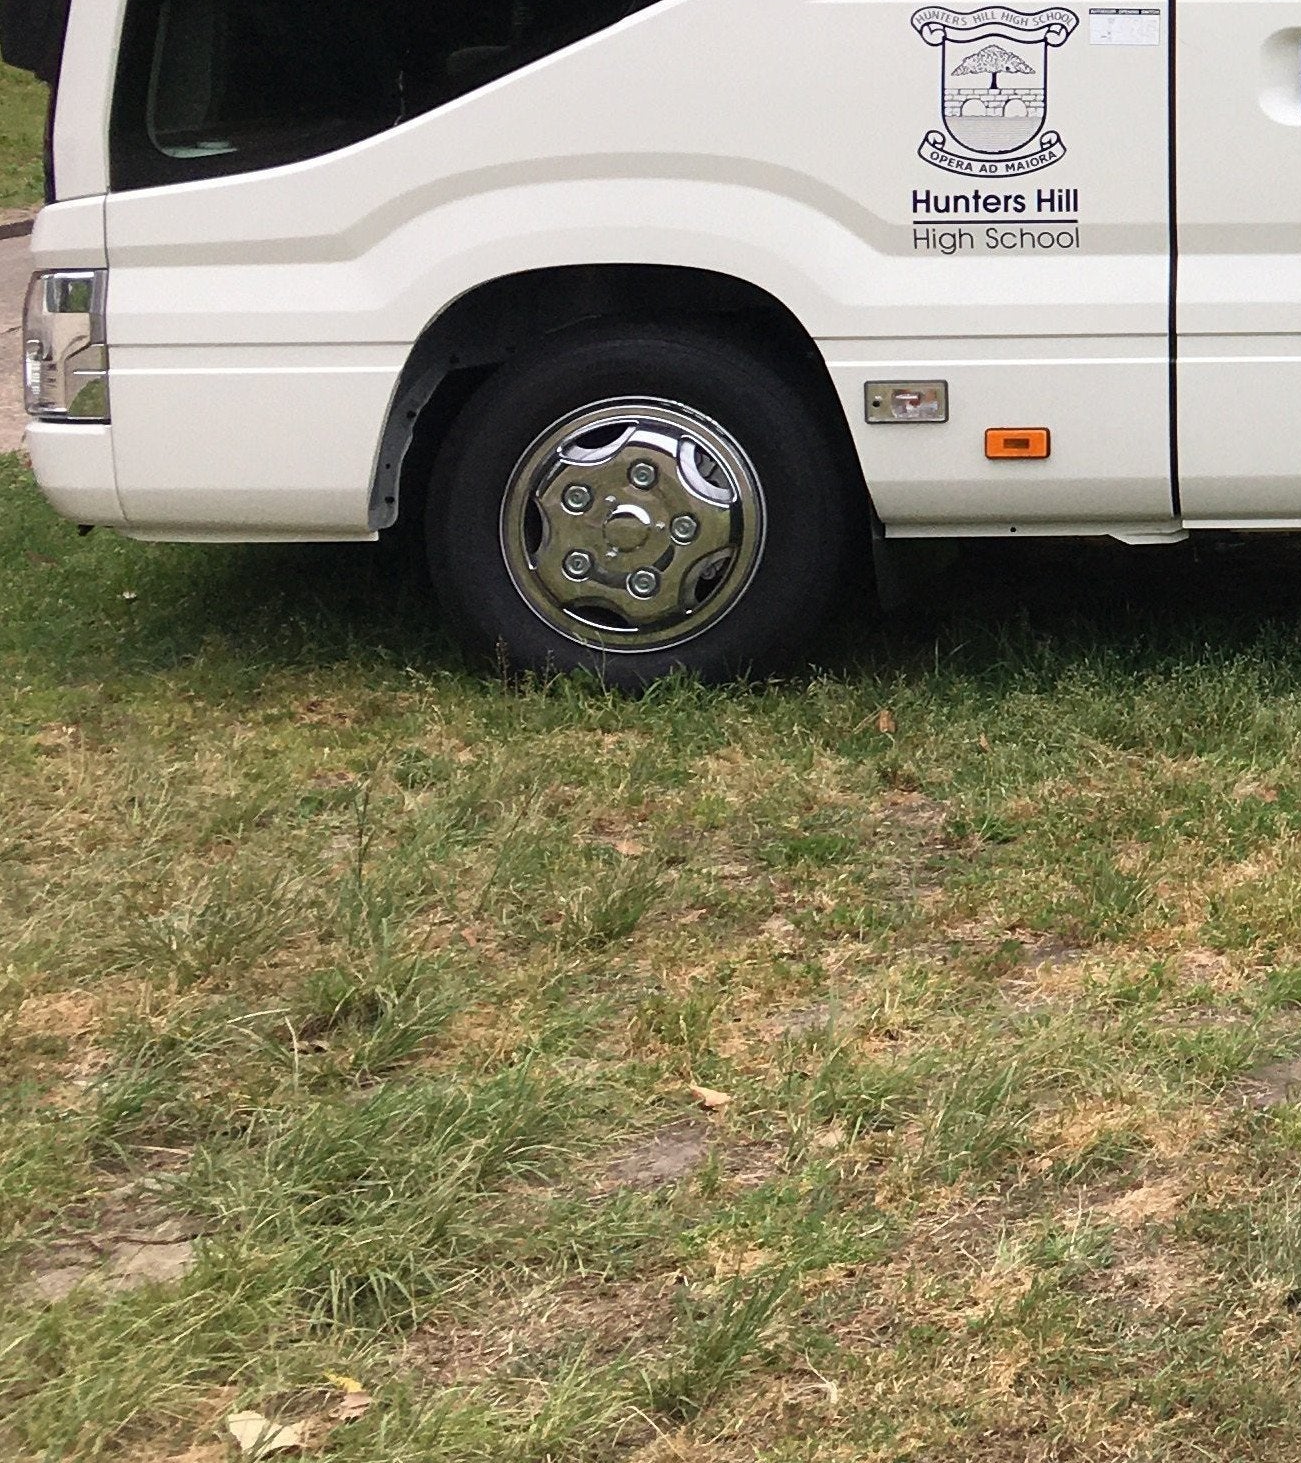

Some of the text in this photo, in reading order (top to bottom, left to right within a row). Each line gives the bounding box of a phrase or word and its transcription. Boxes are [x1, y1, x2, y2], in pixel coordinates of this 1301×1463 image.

[915, 11, 967, 26] HUNTERS
[973, 11, 997, 24] HILL
[1001, 12, 1029, 26] HIGH
[1033, 11, 1075, 26] SCHOOL
[929, 150, 1057, 174] OPERA AD MAIORA
[913, 189, 1078, 213] Hunters Hill
[913, 227, 1079, 254] High School
